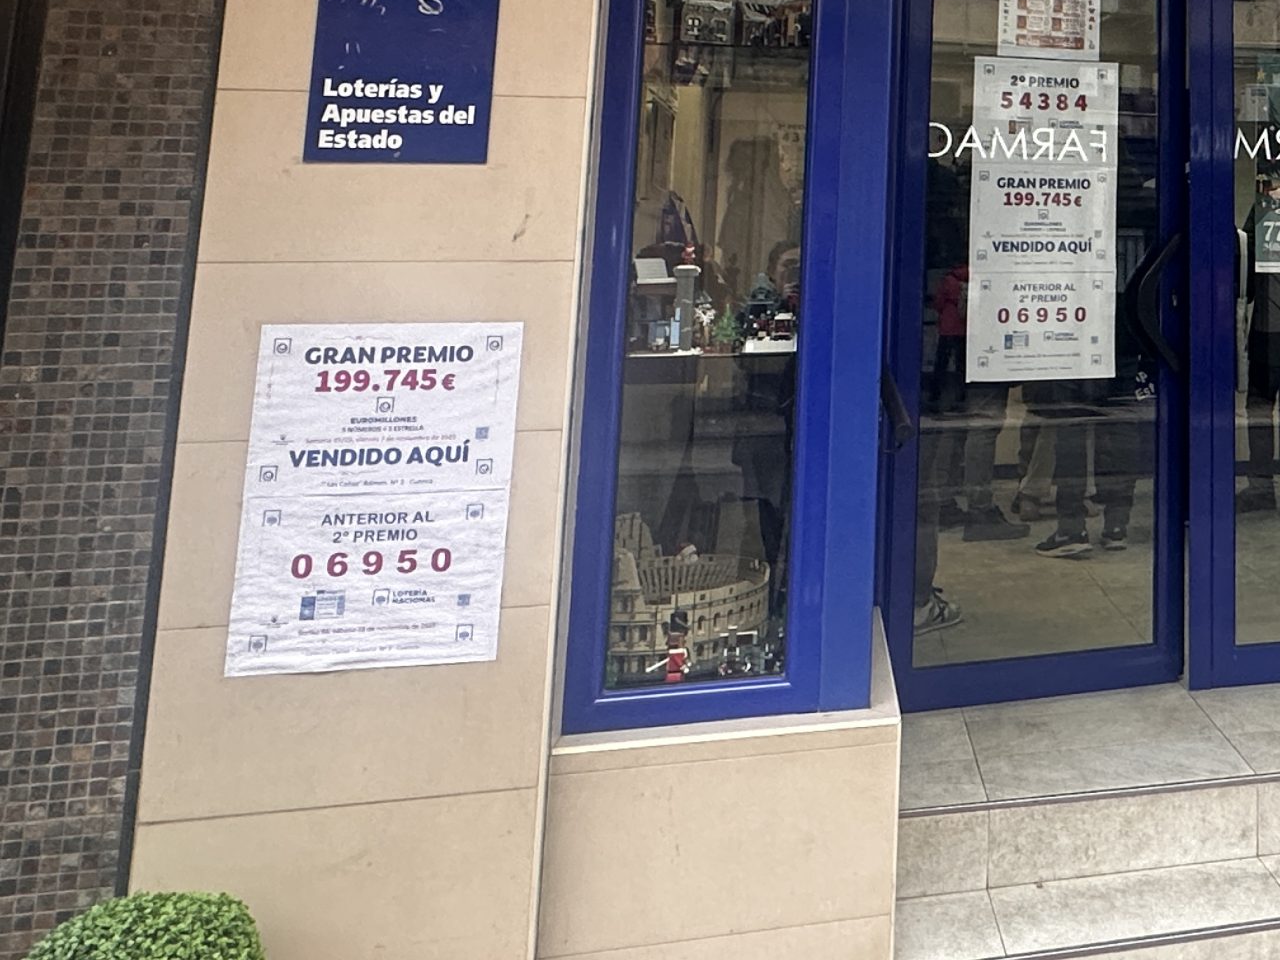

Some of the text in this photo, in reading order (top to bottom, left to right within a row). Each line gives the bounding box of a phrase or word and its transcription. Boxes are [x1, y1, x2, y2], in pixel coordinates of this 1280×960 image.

[1010, 75, 1080, 89] 2º PREMIO
[322, 78, 443, 103] Loterías y
[1001, 92, 1088, 112] 54384
[321, 103, 475, 127] Apuestas del
[317, 129, 403, 150] Estado
[997, 177, 1091, 190] GRAN PREMIO
[1003, 192, 1082, 207] 199.745€
[992, 238, 1092, 253] VENDIDO AQUÍ
[1013, 283, 1076, 292] ANTERIOR AL
[1031, 294, 1068, 303] PREMIO
[997, 307, 1087, 324] 06950
[304, 345, 474, 365] GRAN PREMIO
[314, 369, 456, 393] 199.745€
[350, 416, 418, 425] EUROMILLONES
[289, 440, 470, 468] VENDIDO AQUÍ
[321, 511, 435, 527] ANTERIOR AL
[333, 529, 418, 544] 2º PREMIO
[290, 548, 452, 579] 06950
